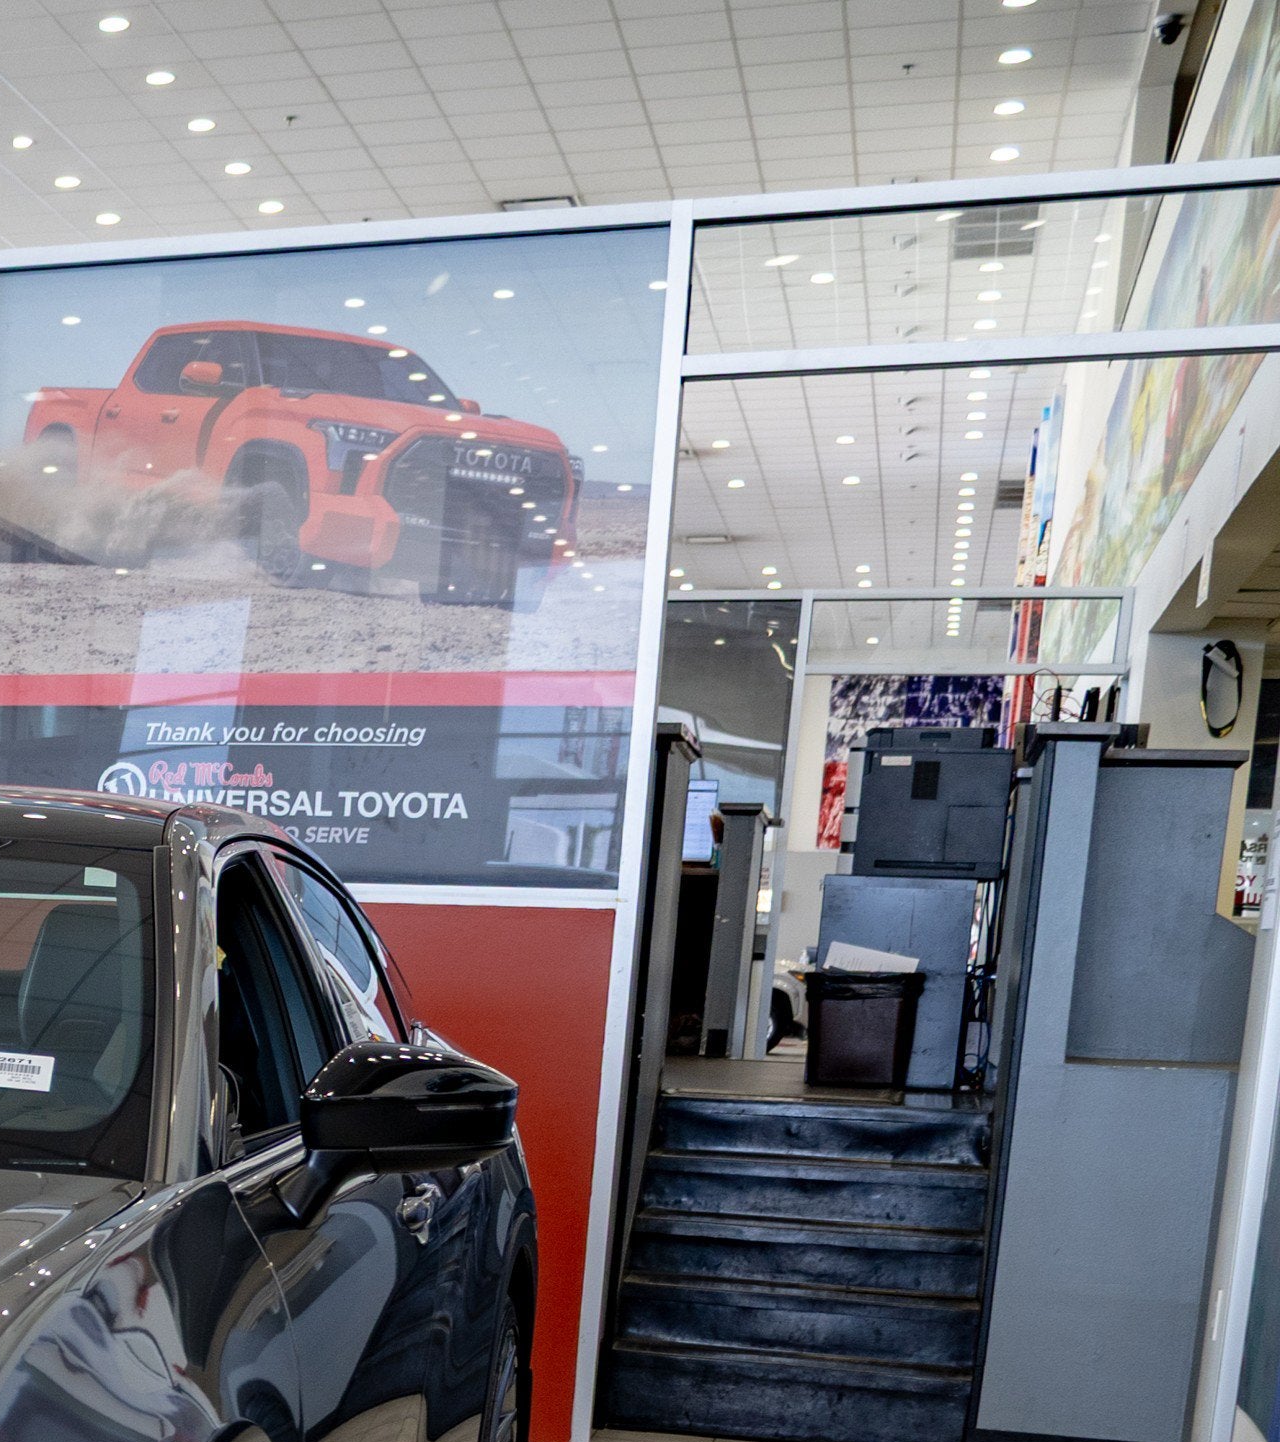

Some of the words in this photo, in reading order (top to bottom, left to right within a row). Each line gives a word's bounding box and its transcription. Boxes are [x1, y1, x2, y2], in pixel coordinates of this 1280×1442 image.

[452, 446, 533, 474] TOYOTA
[146, 721, 216, 744] Thank
[219, 726, 265, 746] you
[272, 721, 309, 743] for
[313, 721, 427, 748] choosing
[148, 760, 187, 793] Red
[189, 761, 273, 788] McCombs
[338, 790, 469, 820] TOYOTA
[304, 827, 370, 845] SERVE
